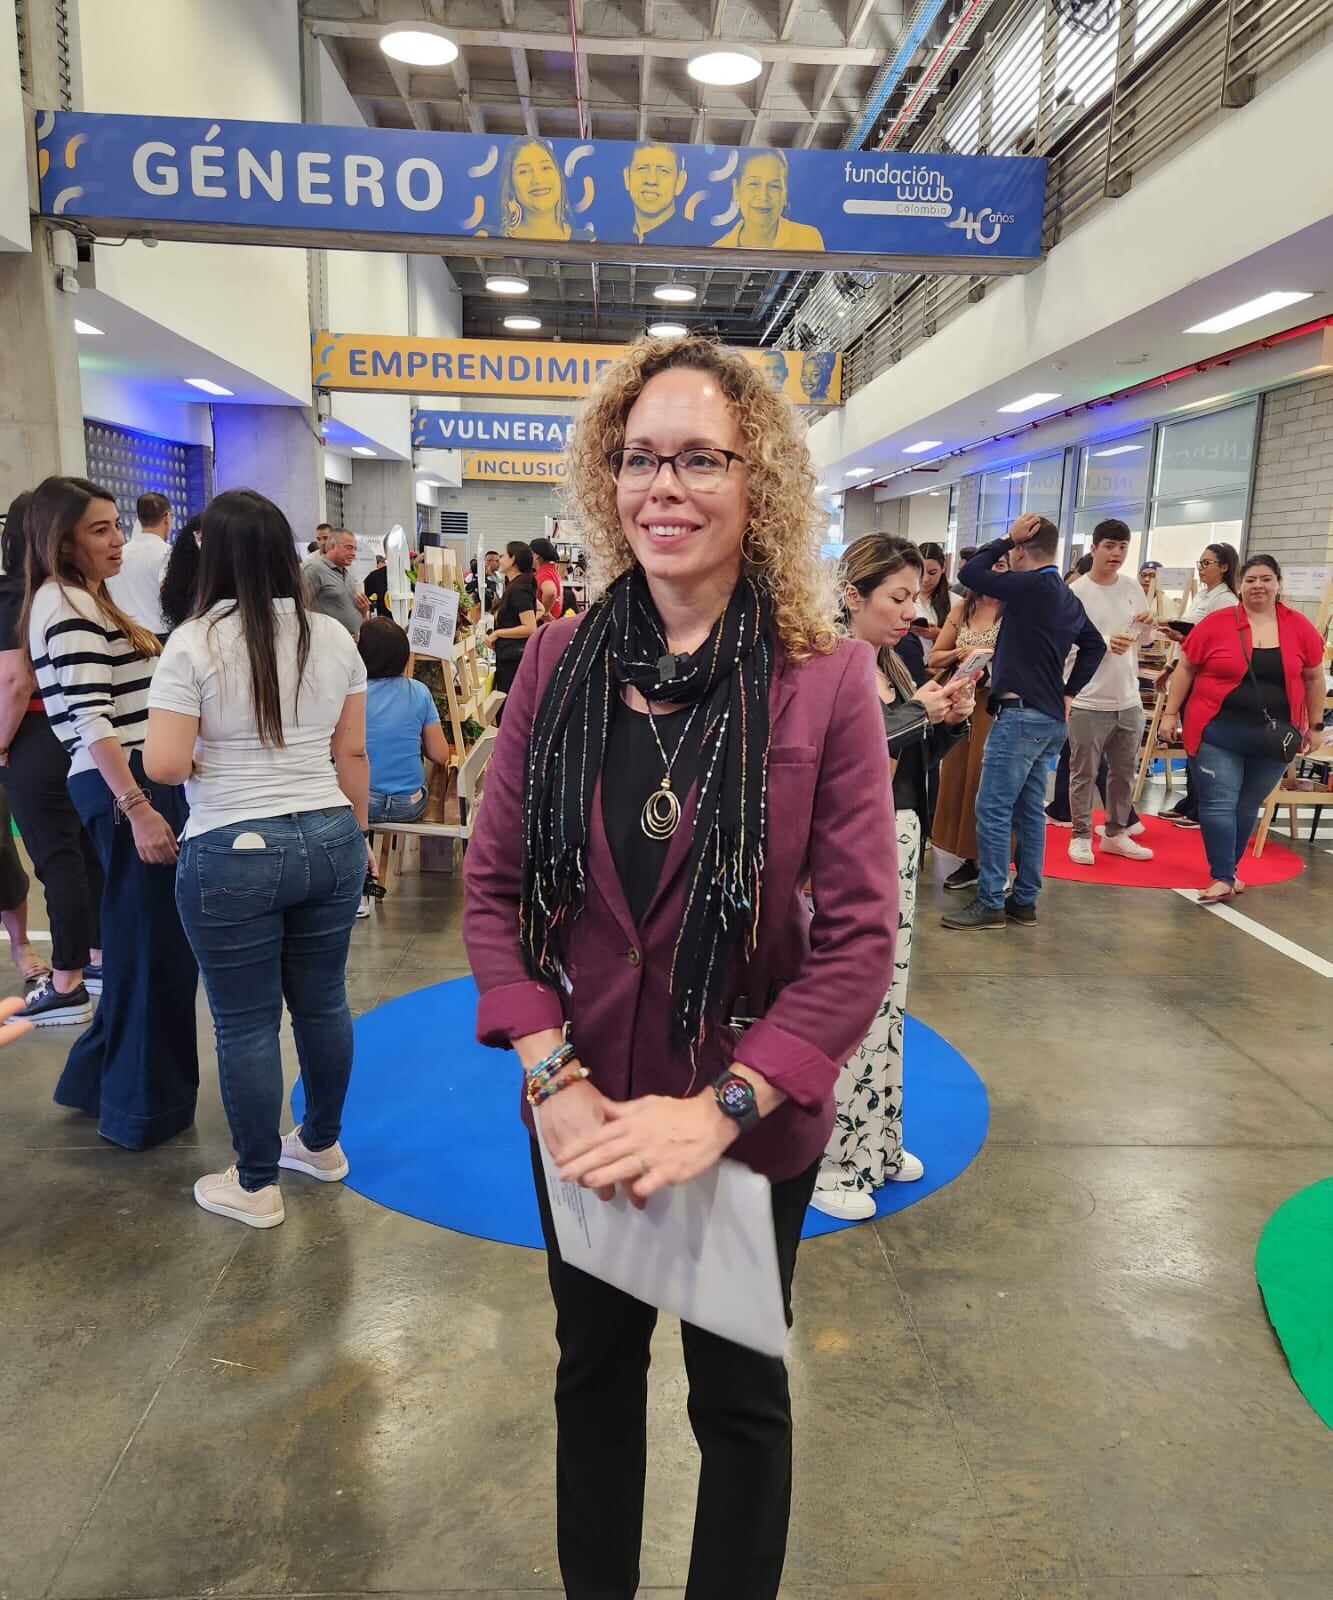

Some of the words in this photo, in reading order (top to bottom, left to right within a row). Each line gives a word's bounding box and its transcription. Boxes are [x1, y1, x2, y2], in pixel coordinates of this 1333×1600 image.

[132, 124, 444, 212] GÉNERO
[844, 161, 941, 186] fundación
[896, 175, 954, 202] wwb
[896, 203, 947, 215] Colombia
[945, 206, 1001, 245] 40
[988, 212, 1016, 224] años
